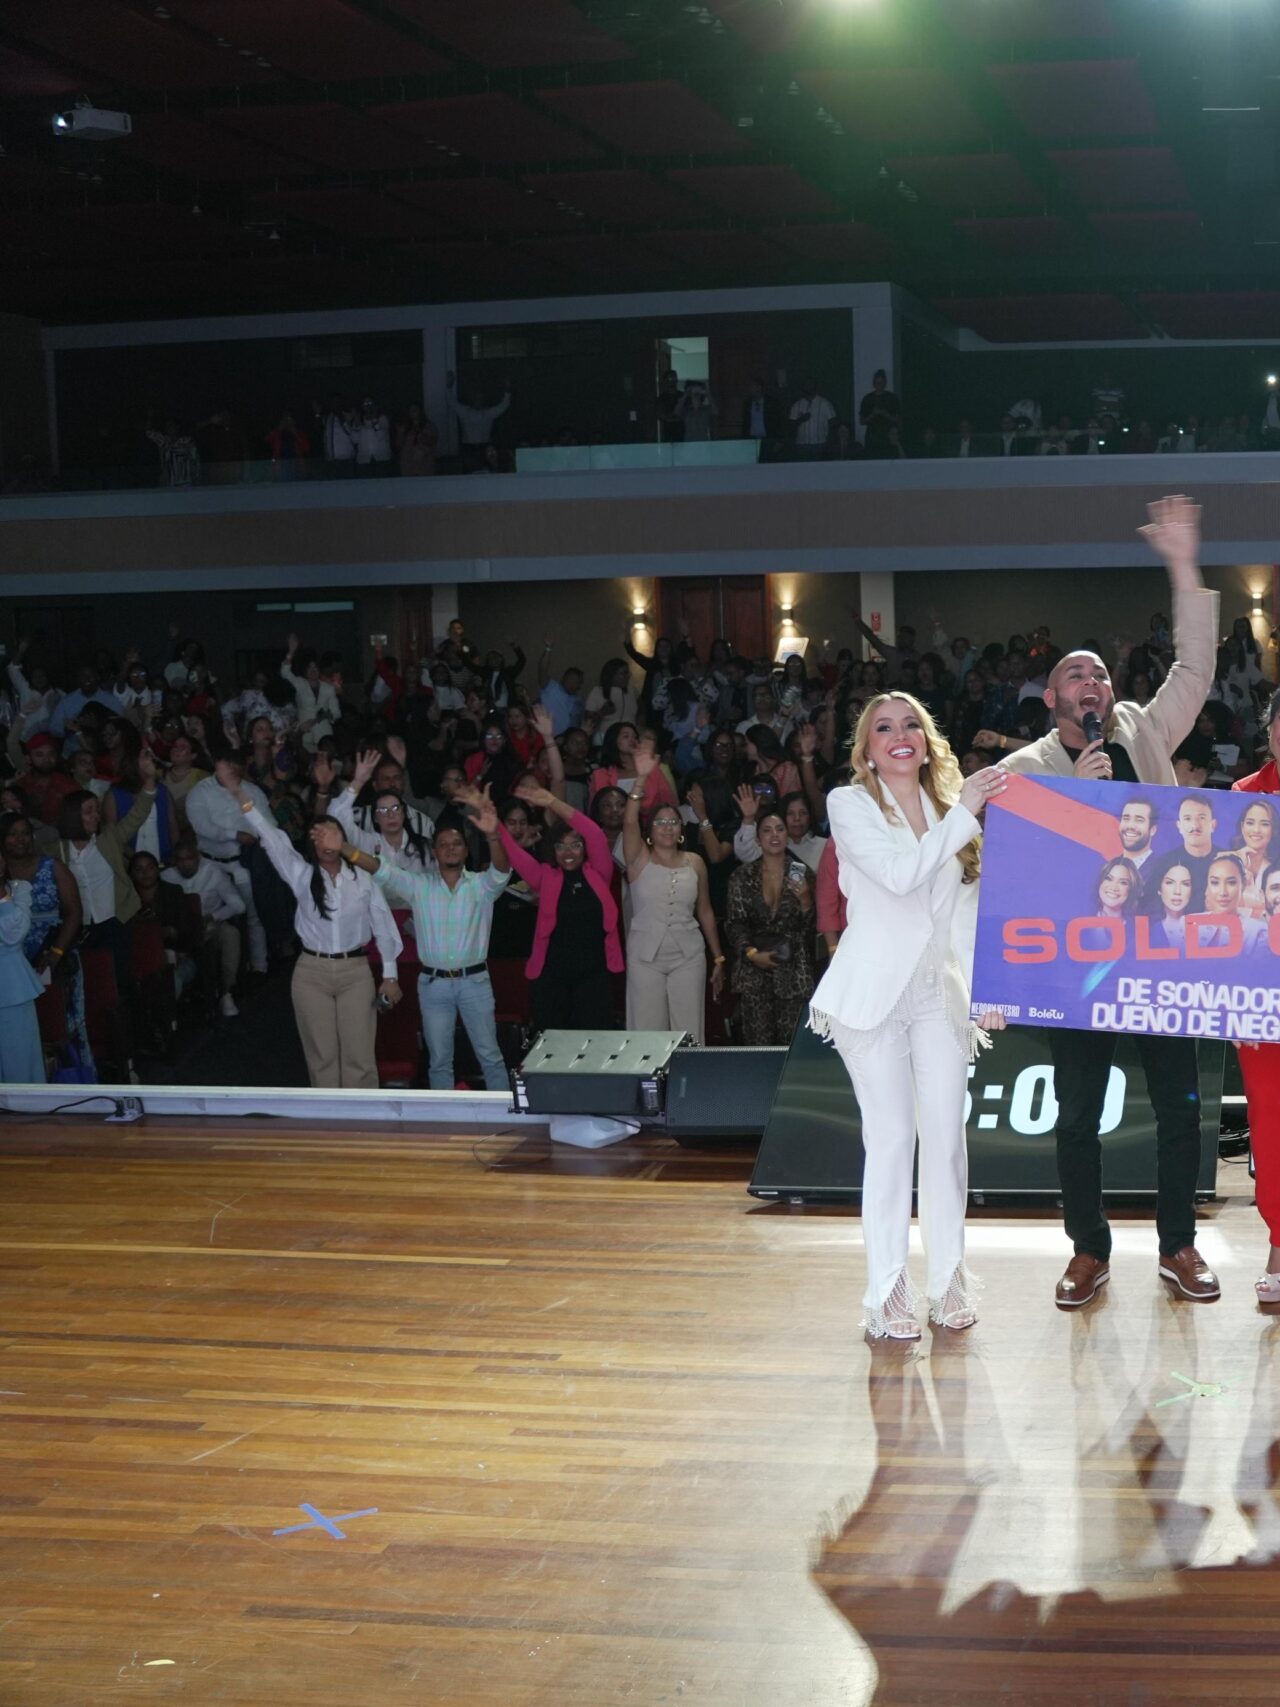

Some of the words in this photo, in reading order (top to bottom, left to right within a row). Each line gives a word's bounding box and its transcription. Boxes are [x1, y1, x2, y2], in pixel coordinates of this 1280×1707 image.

[1002, 914, 1244, 964] SOLD
[1117, 977, 1152, 1005] DE
[1091, 1002, 1182, 1034] DUEÑO
[1186, 1009, 1221, 1037] DE
